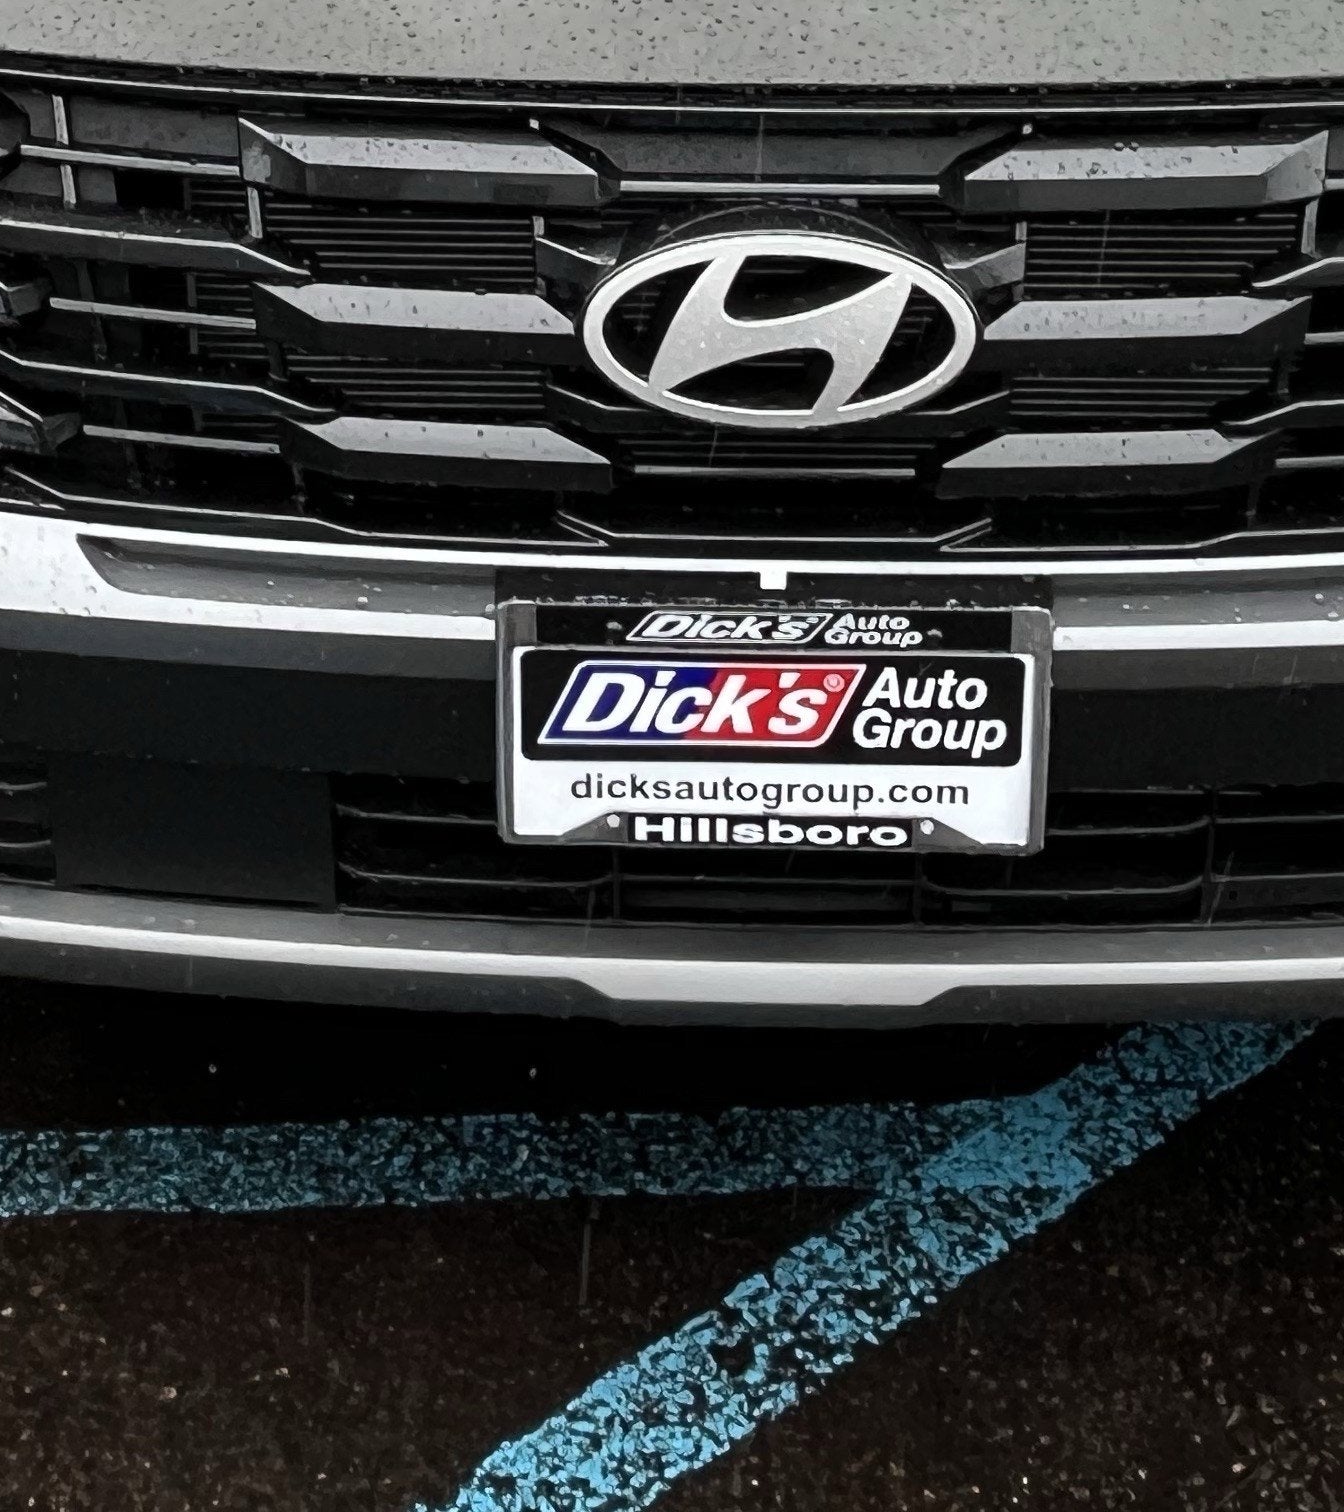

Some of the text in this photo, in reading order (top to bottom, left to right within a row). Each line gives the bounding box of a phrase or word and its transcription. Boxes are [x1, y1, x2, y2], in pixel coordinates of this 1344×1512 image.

[824, 628, 924, 648] Group
[832, 613, 911, 631] Auto
[862, 667, 988, 711] Auto
[852, 709, 1008, 759] Group
[570, 772, 969, 811] dicksautogroup.com
[634, 816, 909, 847] Hillsboro
